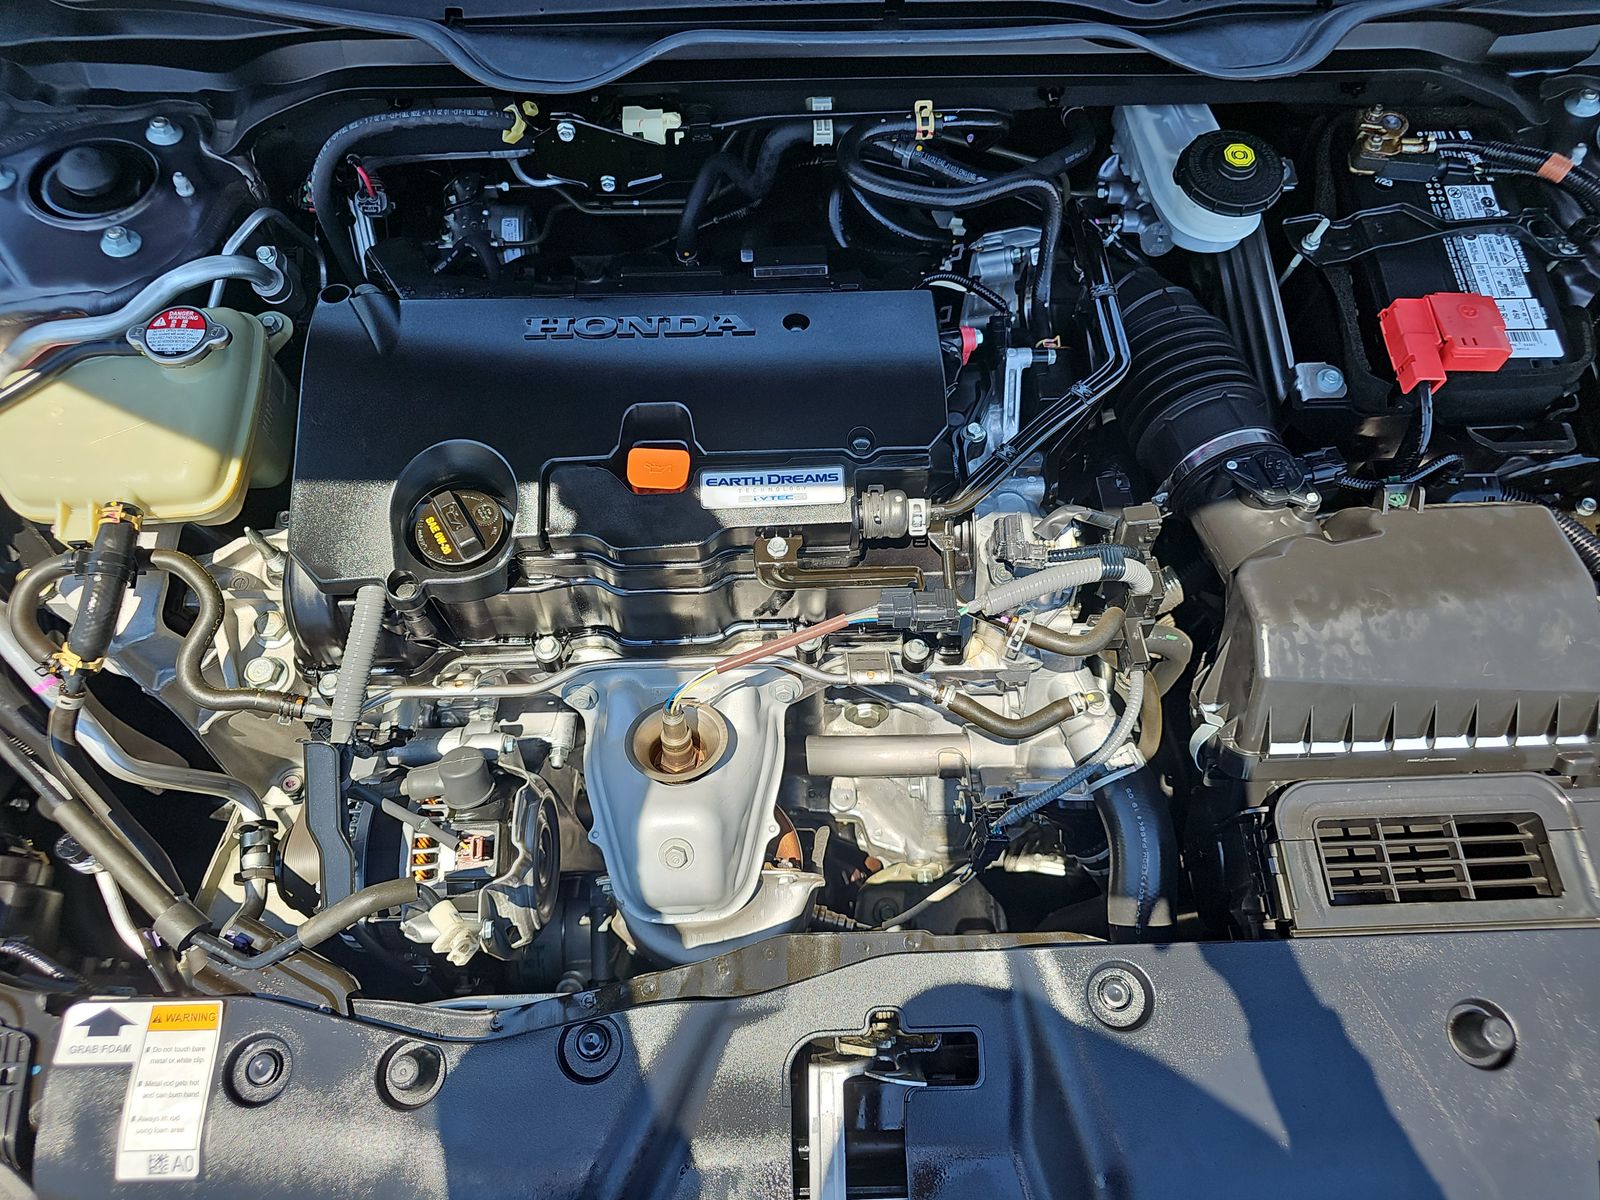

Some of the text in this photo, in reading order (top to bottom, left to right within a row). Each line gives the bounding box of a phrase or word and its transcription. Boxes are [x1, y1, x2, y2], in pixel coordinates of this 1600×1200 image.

[1512, 309, 1520, 320] 450
[524, 313, 756, 340] HONDA
[706, 473, 839, 487] EARTH DREAMS
[425, 516, 440, 534] SAE
[434, 532, 452, 555] 0W-20
[166, 1012, 216, 1023] WARNING
[69, 1044, 132, 1054] GRAB FOAM
[172, 1154, 194, 1173] A0
